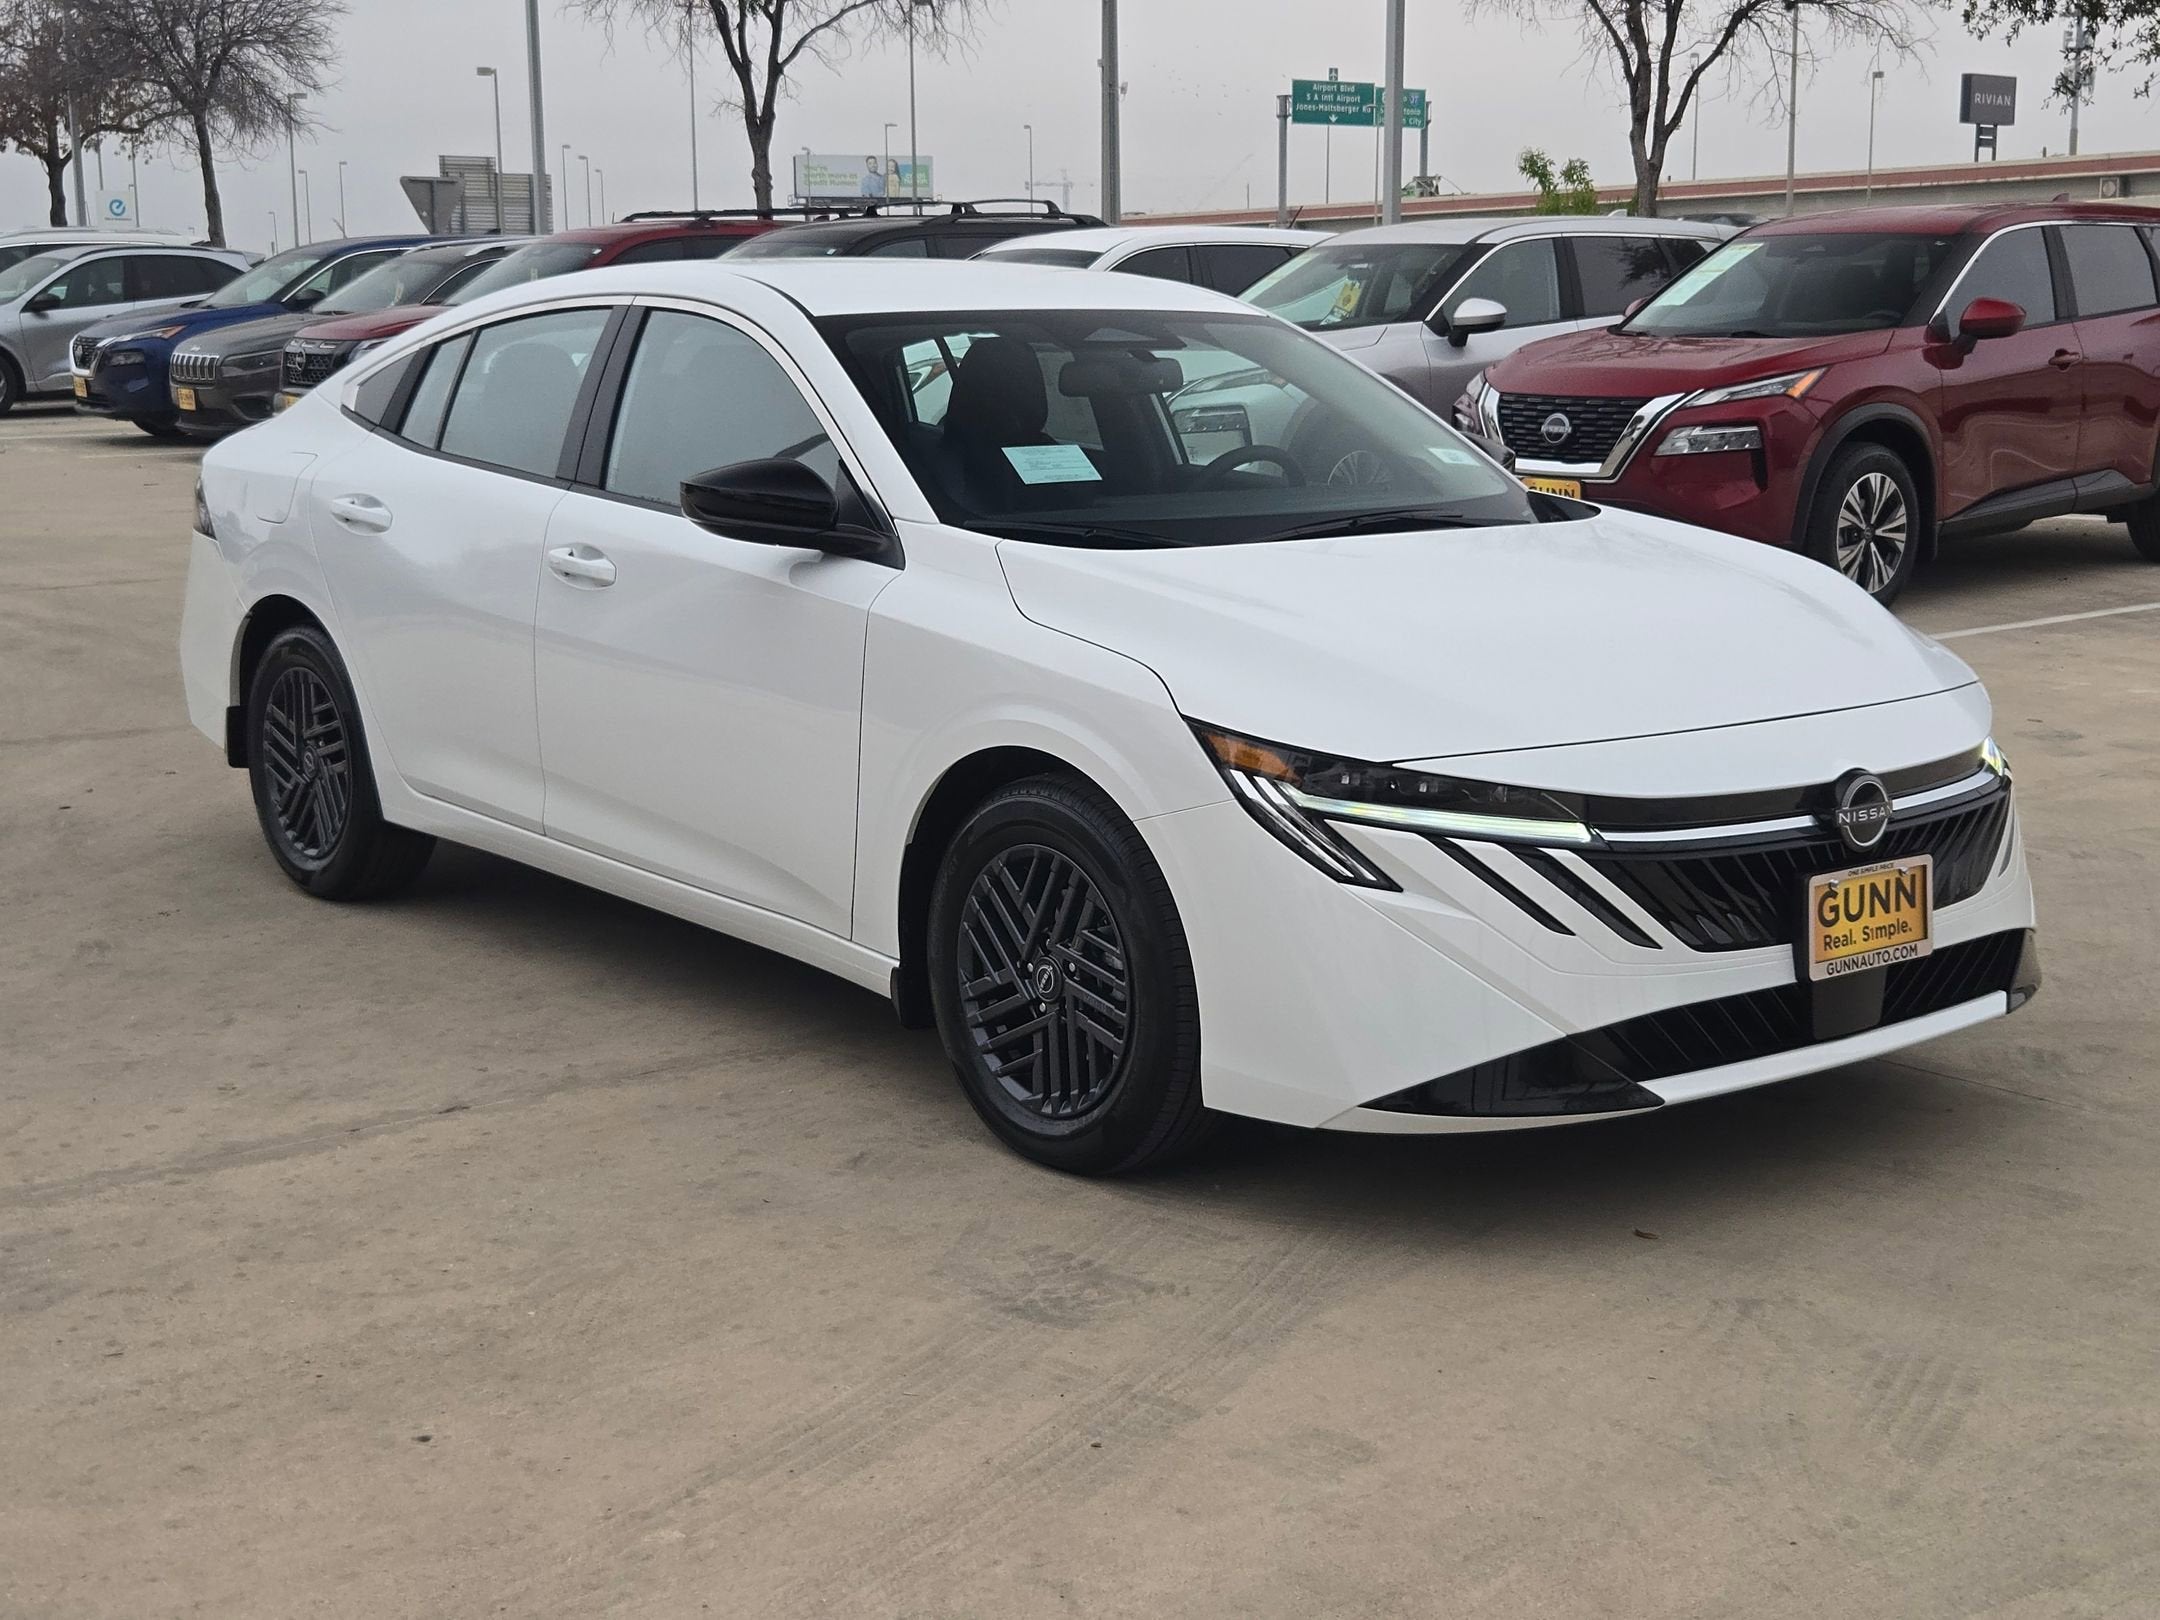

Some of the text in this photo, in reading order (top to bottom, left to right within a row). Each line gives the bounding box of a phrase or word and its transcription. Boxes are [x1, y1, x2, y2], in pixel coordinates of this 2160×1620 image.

[1312, 83, 1356, 93] Airport Blvd
[1306, 93, 1311, 101] S
[1313, 93, 1319, 101] A
[1336, 95, 1361, 104] Airport
[1974, 92, 2011, 106] RIVIAN
[1296, 103, 1360, 115] Jones-Maltsberger
[1408, 117, 1422, 127] City
[1817, 873, 1917, 929] GUNN
[1823, 928, 1857, 952] Real.
[1826, 943, 1919, 976] GUNNAUTO.COM
